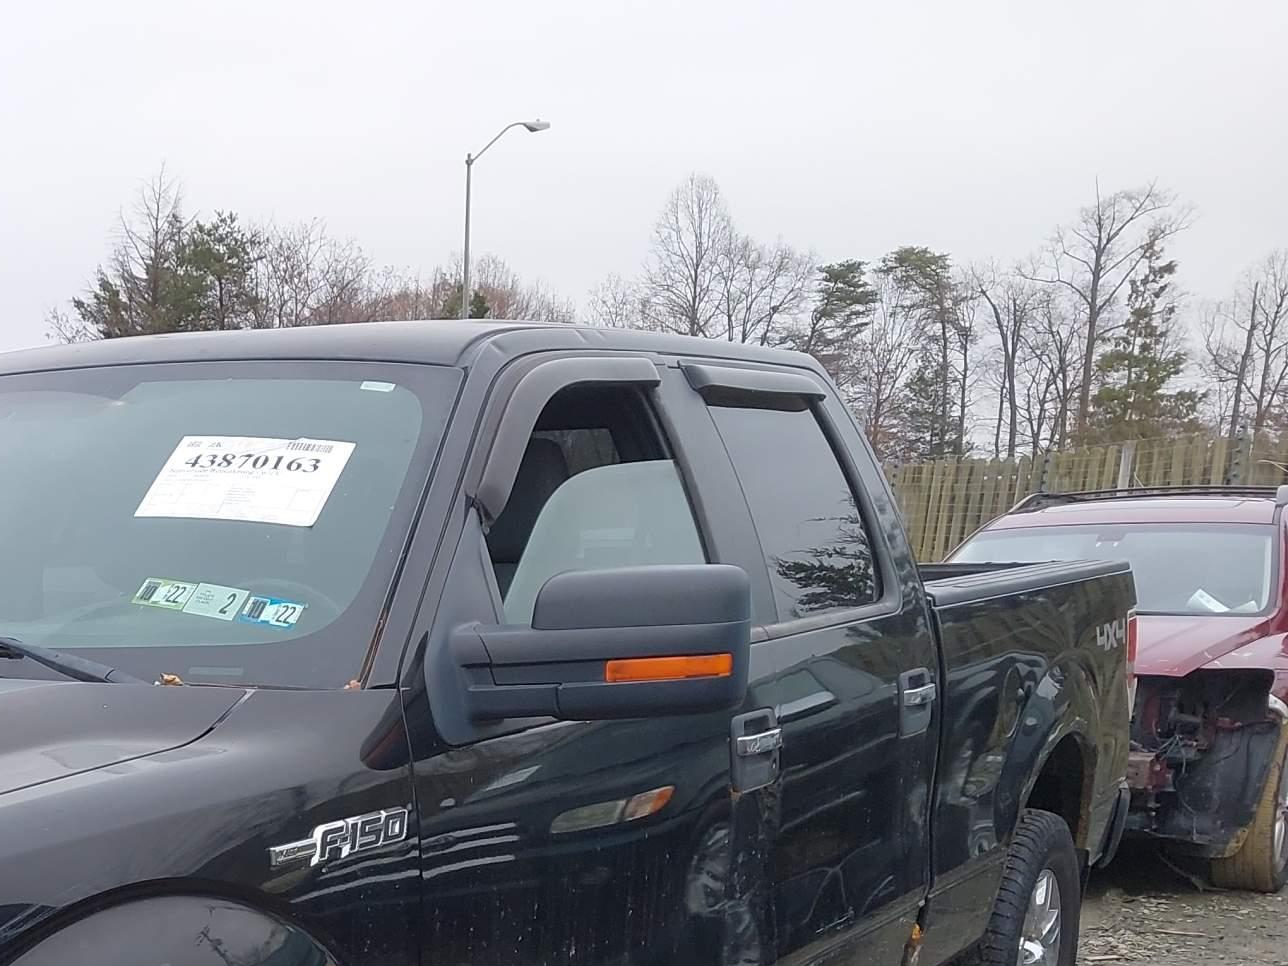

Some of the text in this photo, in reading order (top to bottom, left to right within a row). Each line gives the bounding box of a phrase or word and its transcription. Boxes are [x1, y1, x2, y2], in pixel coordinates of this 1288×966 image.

[185, 453, 321, 473] 43870163
[165, 585, 187, 604] 22
[218, 593, 237, 615] 2
[275, 604, 297, 624] 22
